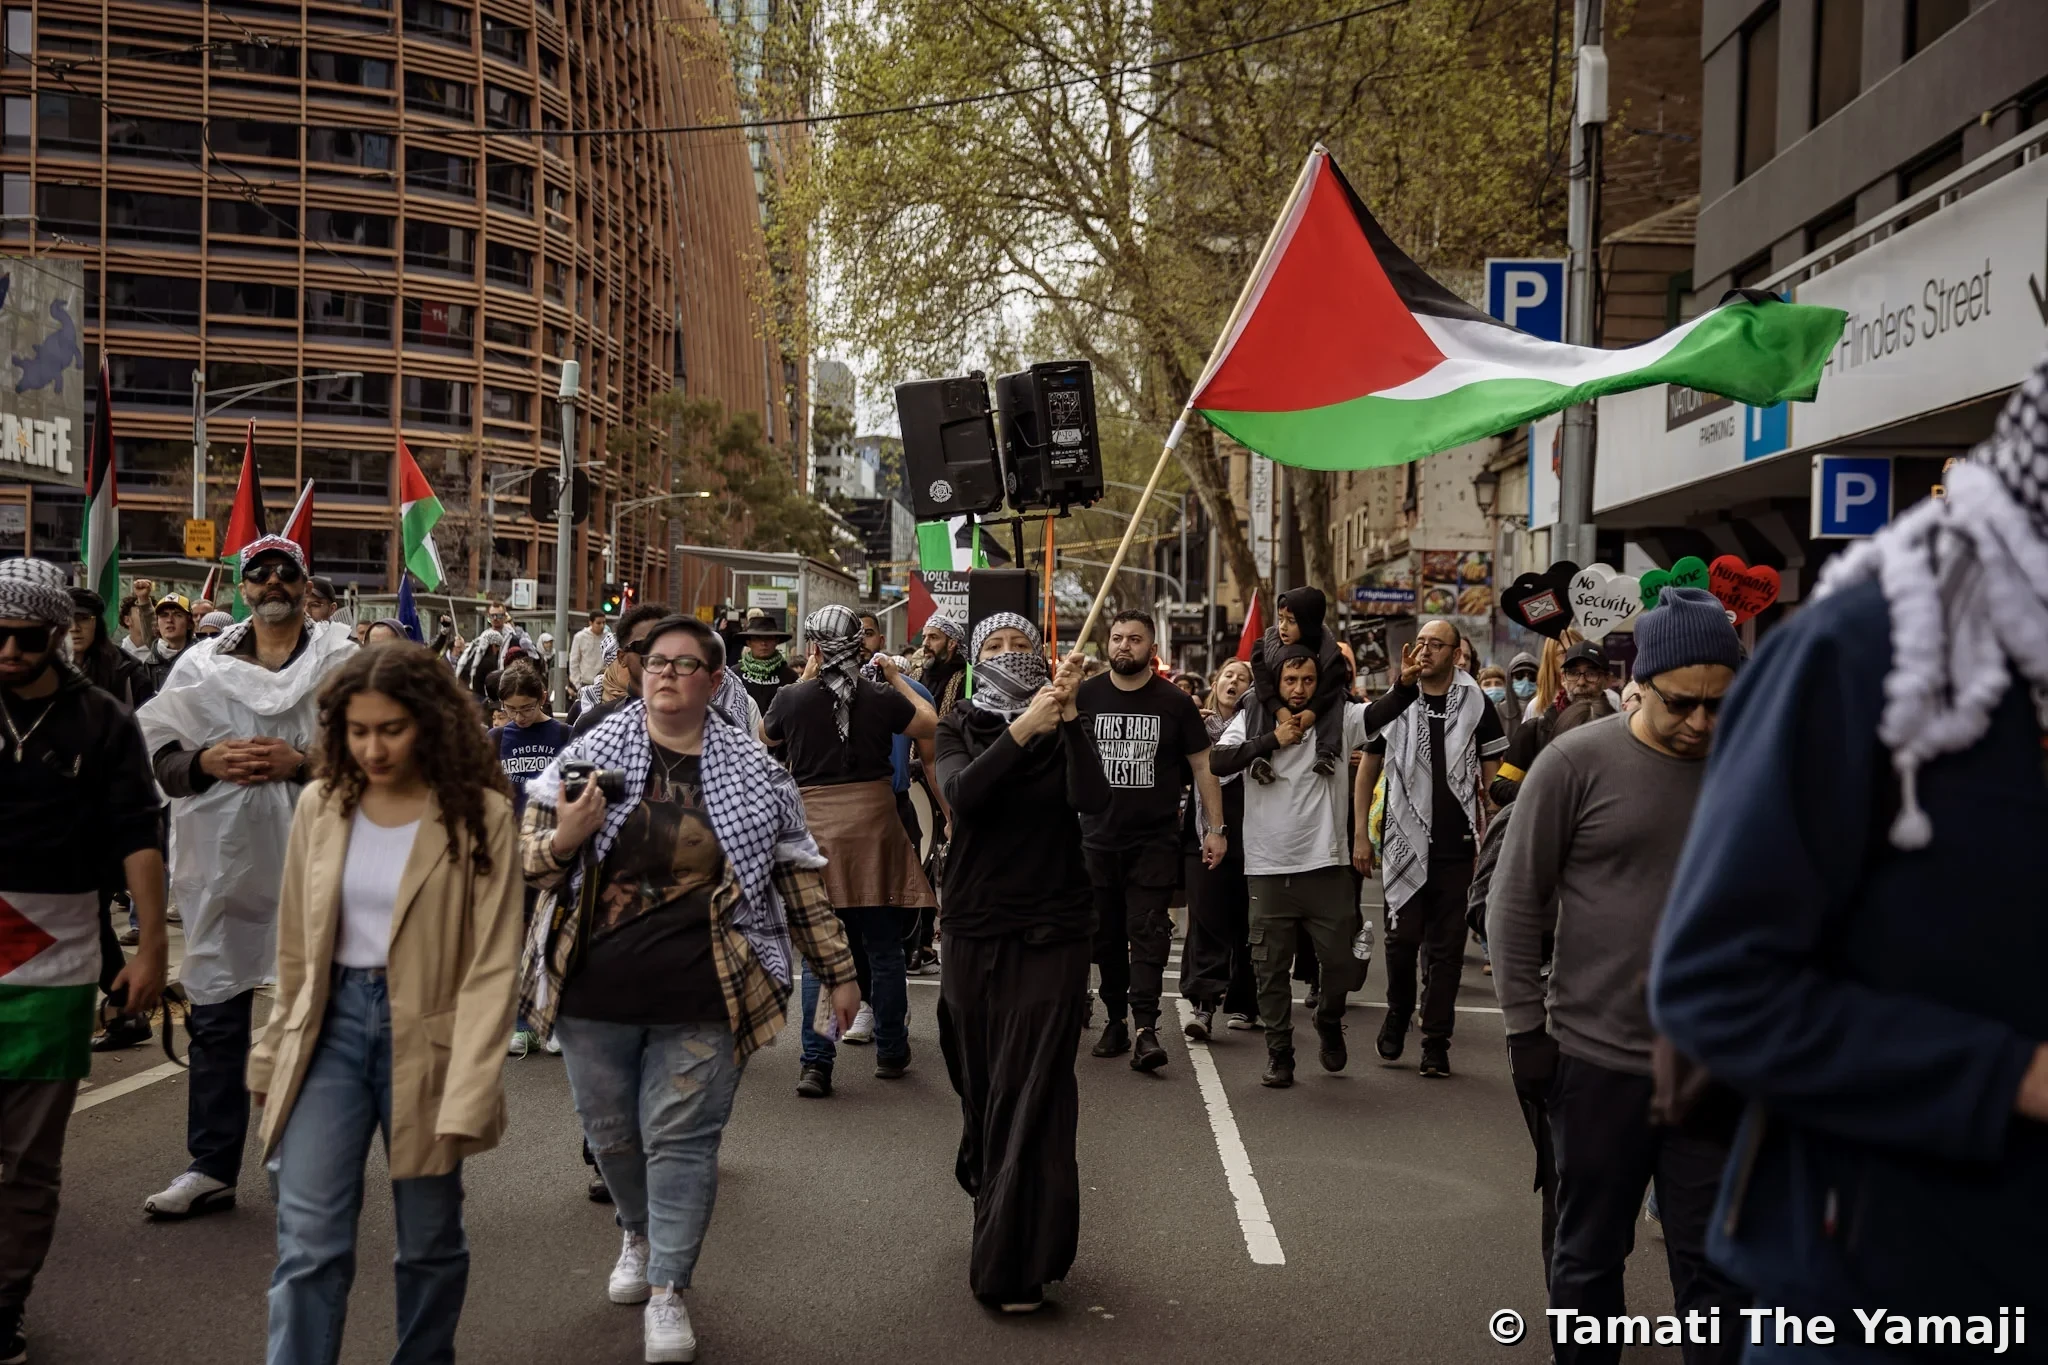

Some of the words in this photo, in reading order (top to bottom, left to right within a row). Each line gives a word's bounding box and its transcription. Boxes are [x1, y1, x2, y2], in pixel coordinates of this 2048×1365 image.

[1504, 271, 1548, 327] P
[1839, 302, 1916, 373] Flinders
[1922, 257, 1992, 340] Street
[1699, 416, 1735, 446] PARKING
[1834, 472, 1877, 523] P
[922, 570, 951, 582] YOUR
[933, 581, 970, 592] SILENC
[1576, 576, 1595, 590] No
[1712, 562, 1778, 602] humanity
[938, 596, 967, 605] WILL
[1575, 593, 1636, 619] security
[1584, 611, 1608, 627] for
[1097, 716, 1123, 739] THIS
[1126, 716, 1158, 740] BABA
[512, 745, 555, 756] PHOENIX
[1098, 741, 1131, 759] STANDS
[1133, 742, 1157, 760] WITH
[1102, 760, 1153, 785] ALESTINE
